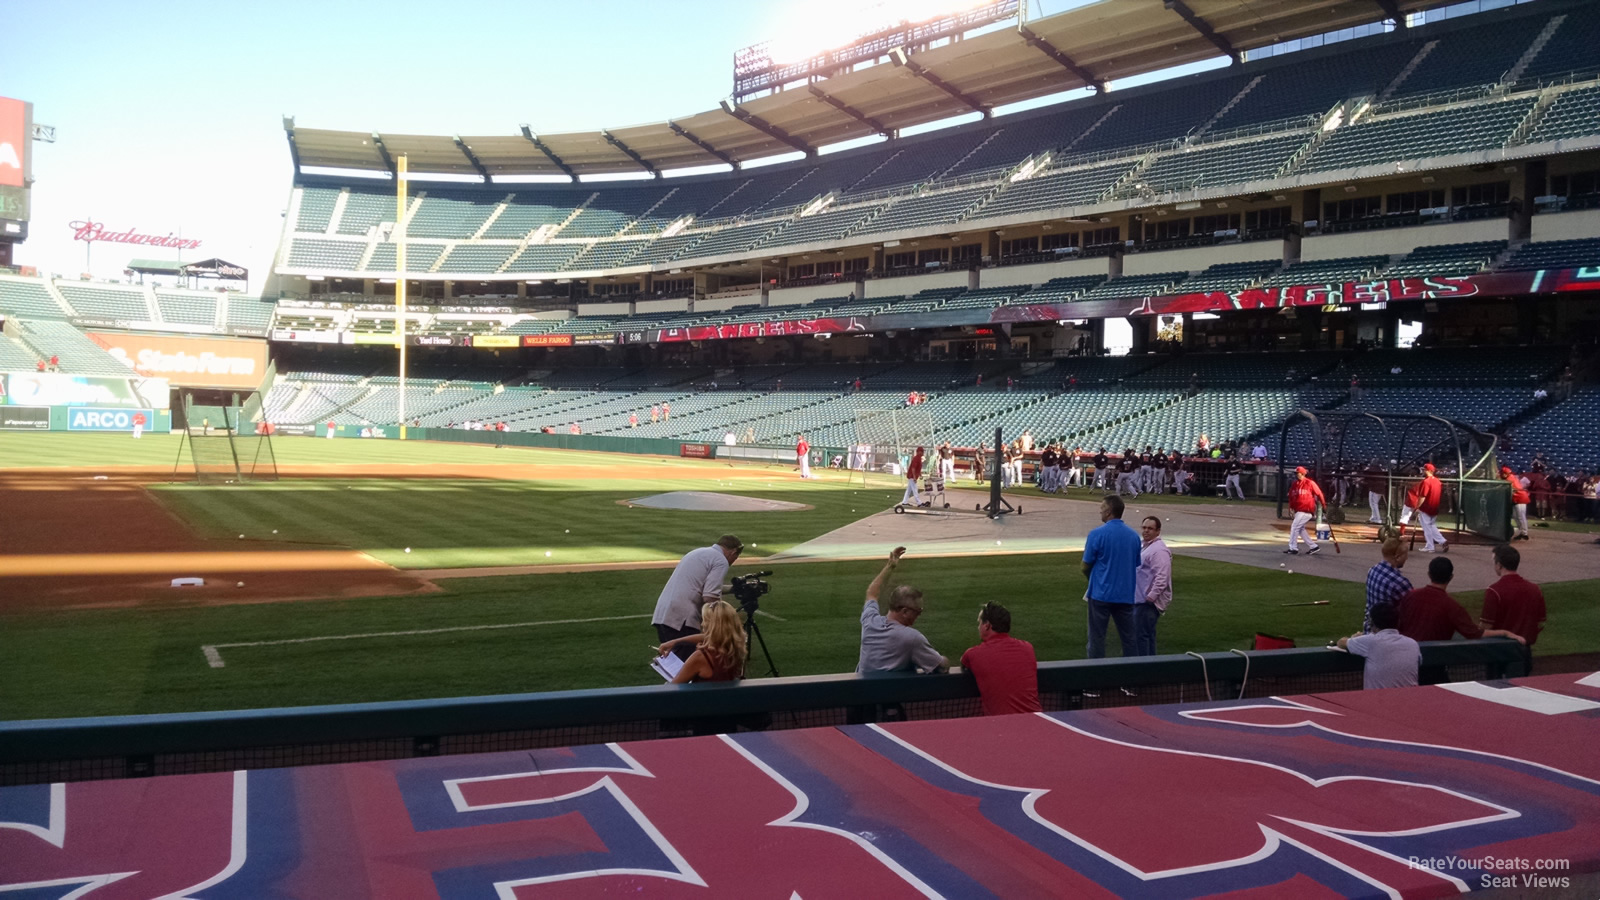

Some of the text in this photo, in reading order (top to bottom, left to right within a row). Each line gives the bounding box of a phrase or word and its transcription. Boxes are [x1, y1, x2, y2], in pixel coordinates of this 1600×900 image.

[69, 220, 202, 249] Budweiser
[418, 336, 452, 345] Yard House
[525, 336, 548, 344] WELLS
[548, 336, 570, 344] FARGO
[629, 332, 641, 342] 5:06
[136, 349, 256, 375] State Farm
[73, 411, 129, 428] ARCO
